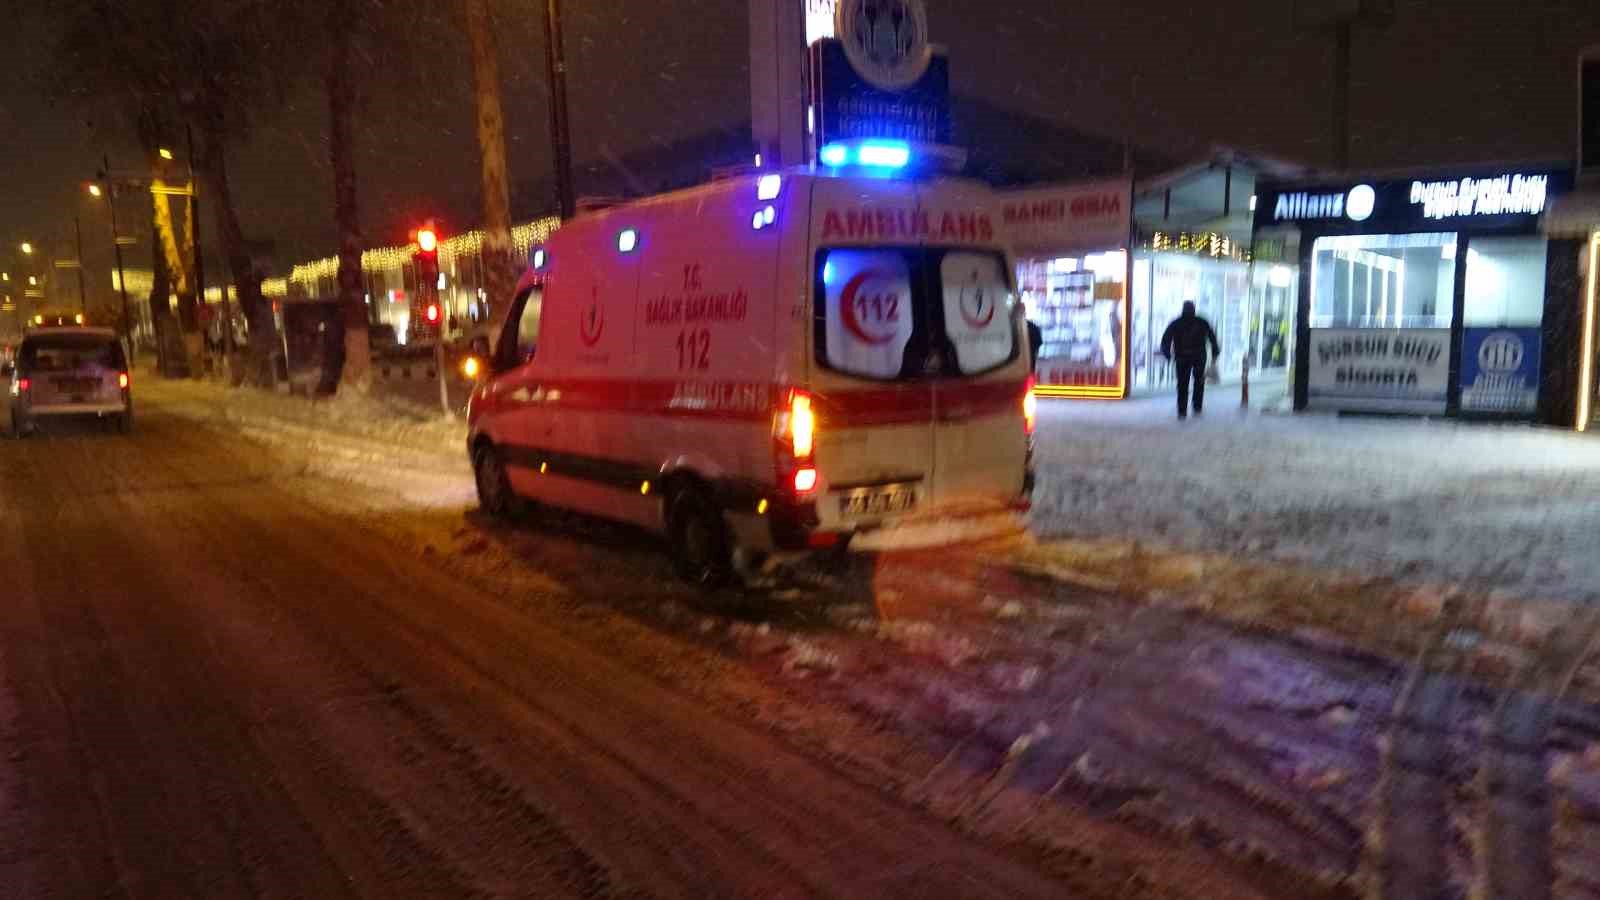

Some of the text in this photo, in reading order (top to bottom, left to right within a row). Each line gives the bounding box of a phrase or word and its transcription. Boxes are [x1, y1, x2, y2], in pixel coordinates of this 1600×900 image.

[1274, 192, 1343, 219] Allianz
[856, 294, 898, 321] 112
[676, 328, 711, 370] 112
